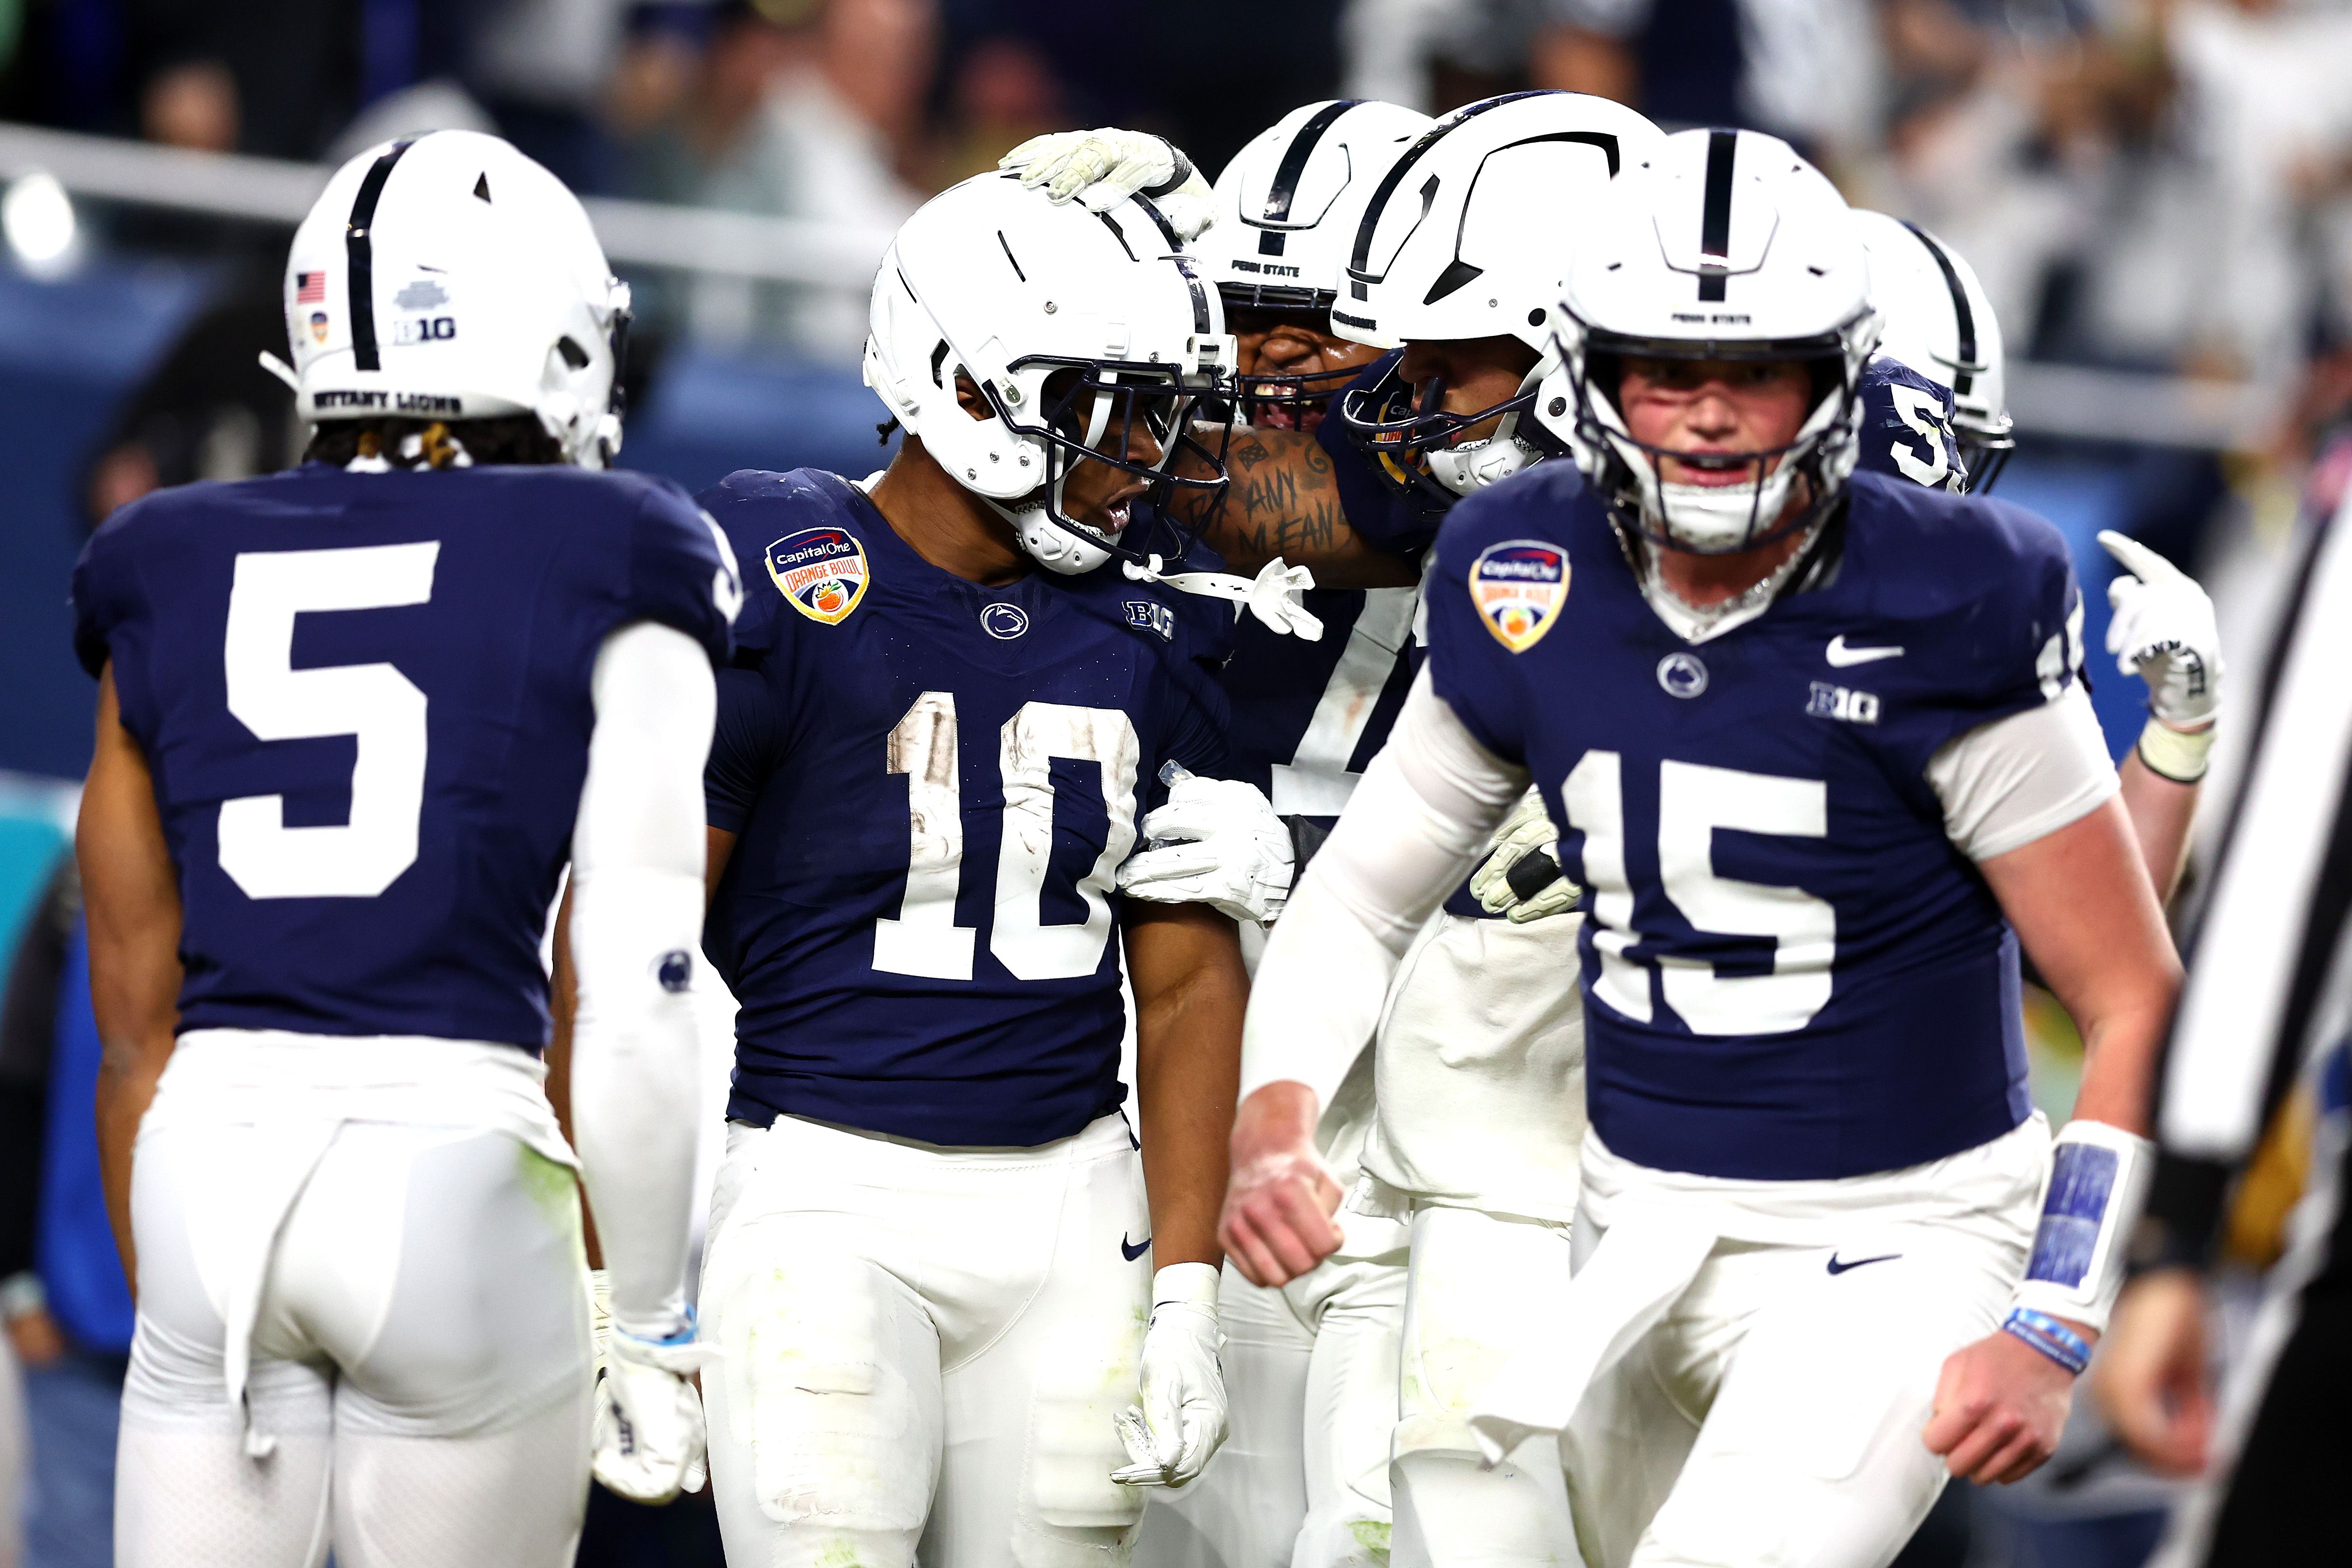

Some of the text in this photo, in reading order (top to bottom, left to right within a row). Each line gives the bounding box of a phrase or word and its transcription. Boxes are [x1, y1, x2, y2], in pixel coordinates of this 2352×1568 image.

[1231, 259, 1300, 277] PENN STATE
[785, 558, 863, 593] ORANGE BOWL
[1246, 463, 1298, 523] ANY
[218, 540, 441, 900] 5
[872, 691, 1140, 980] 10
[1561, 749, 1836, 1035] 15
